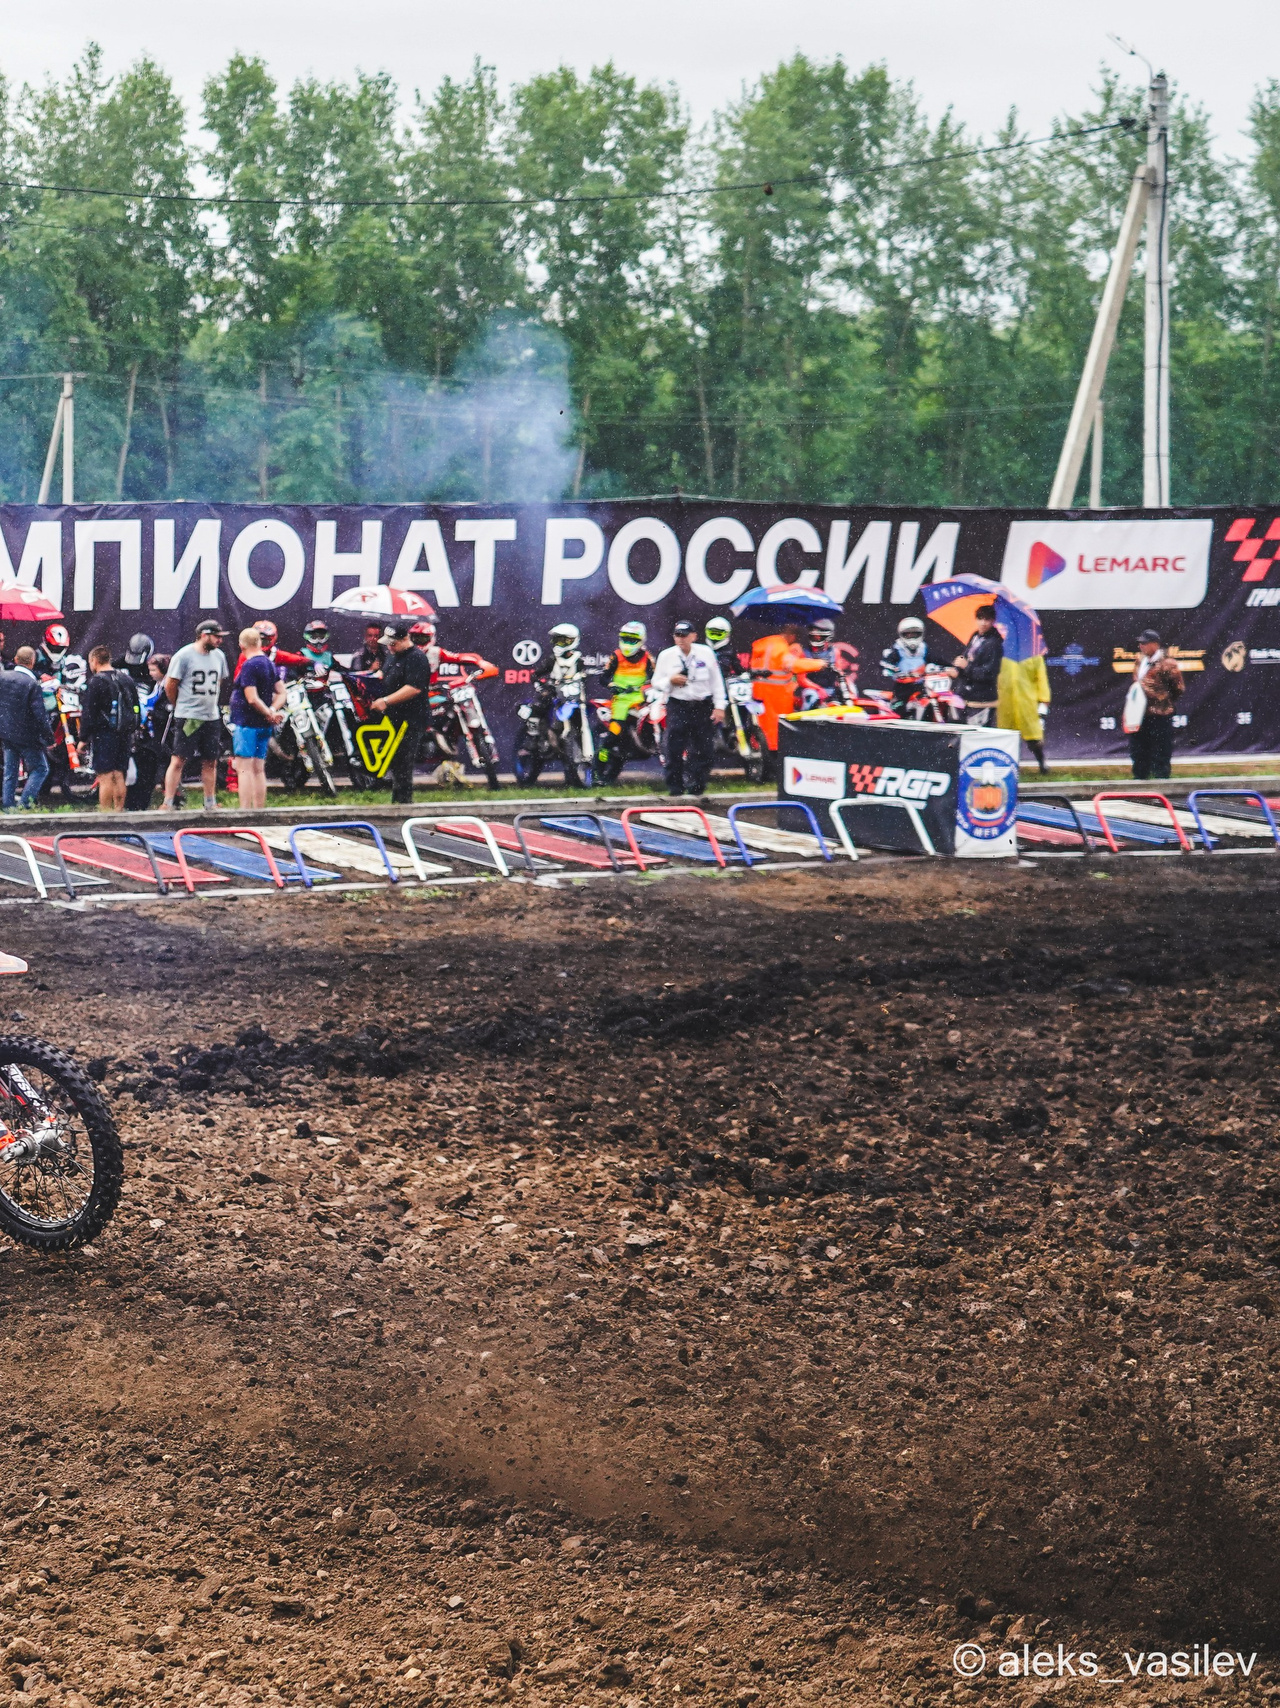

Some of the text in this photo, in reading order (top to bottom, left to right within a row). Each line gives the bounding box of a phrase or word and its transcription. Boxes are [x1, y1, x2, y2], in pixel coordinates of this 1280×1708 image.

[541, 516, 961, 606] РОССИИ
[1077, 553, 1187, 573] LEMARC
[191, 670, 219, 696] 23
[874, 766, 952, 800] RGP
